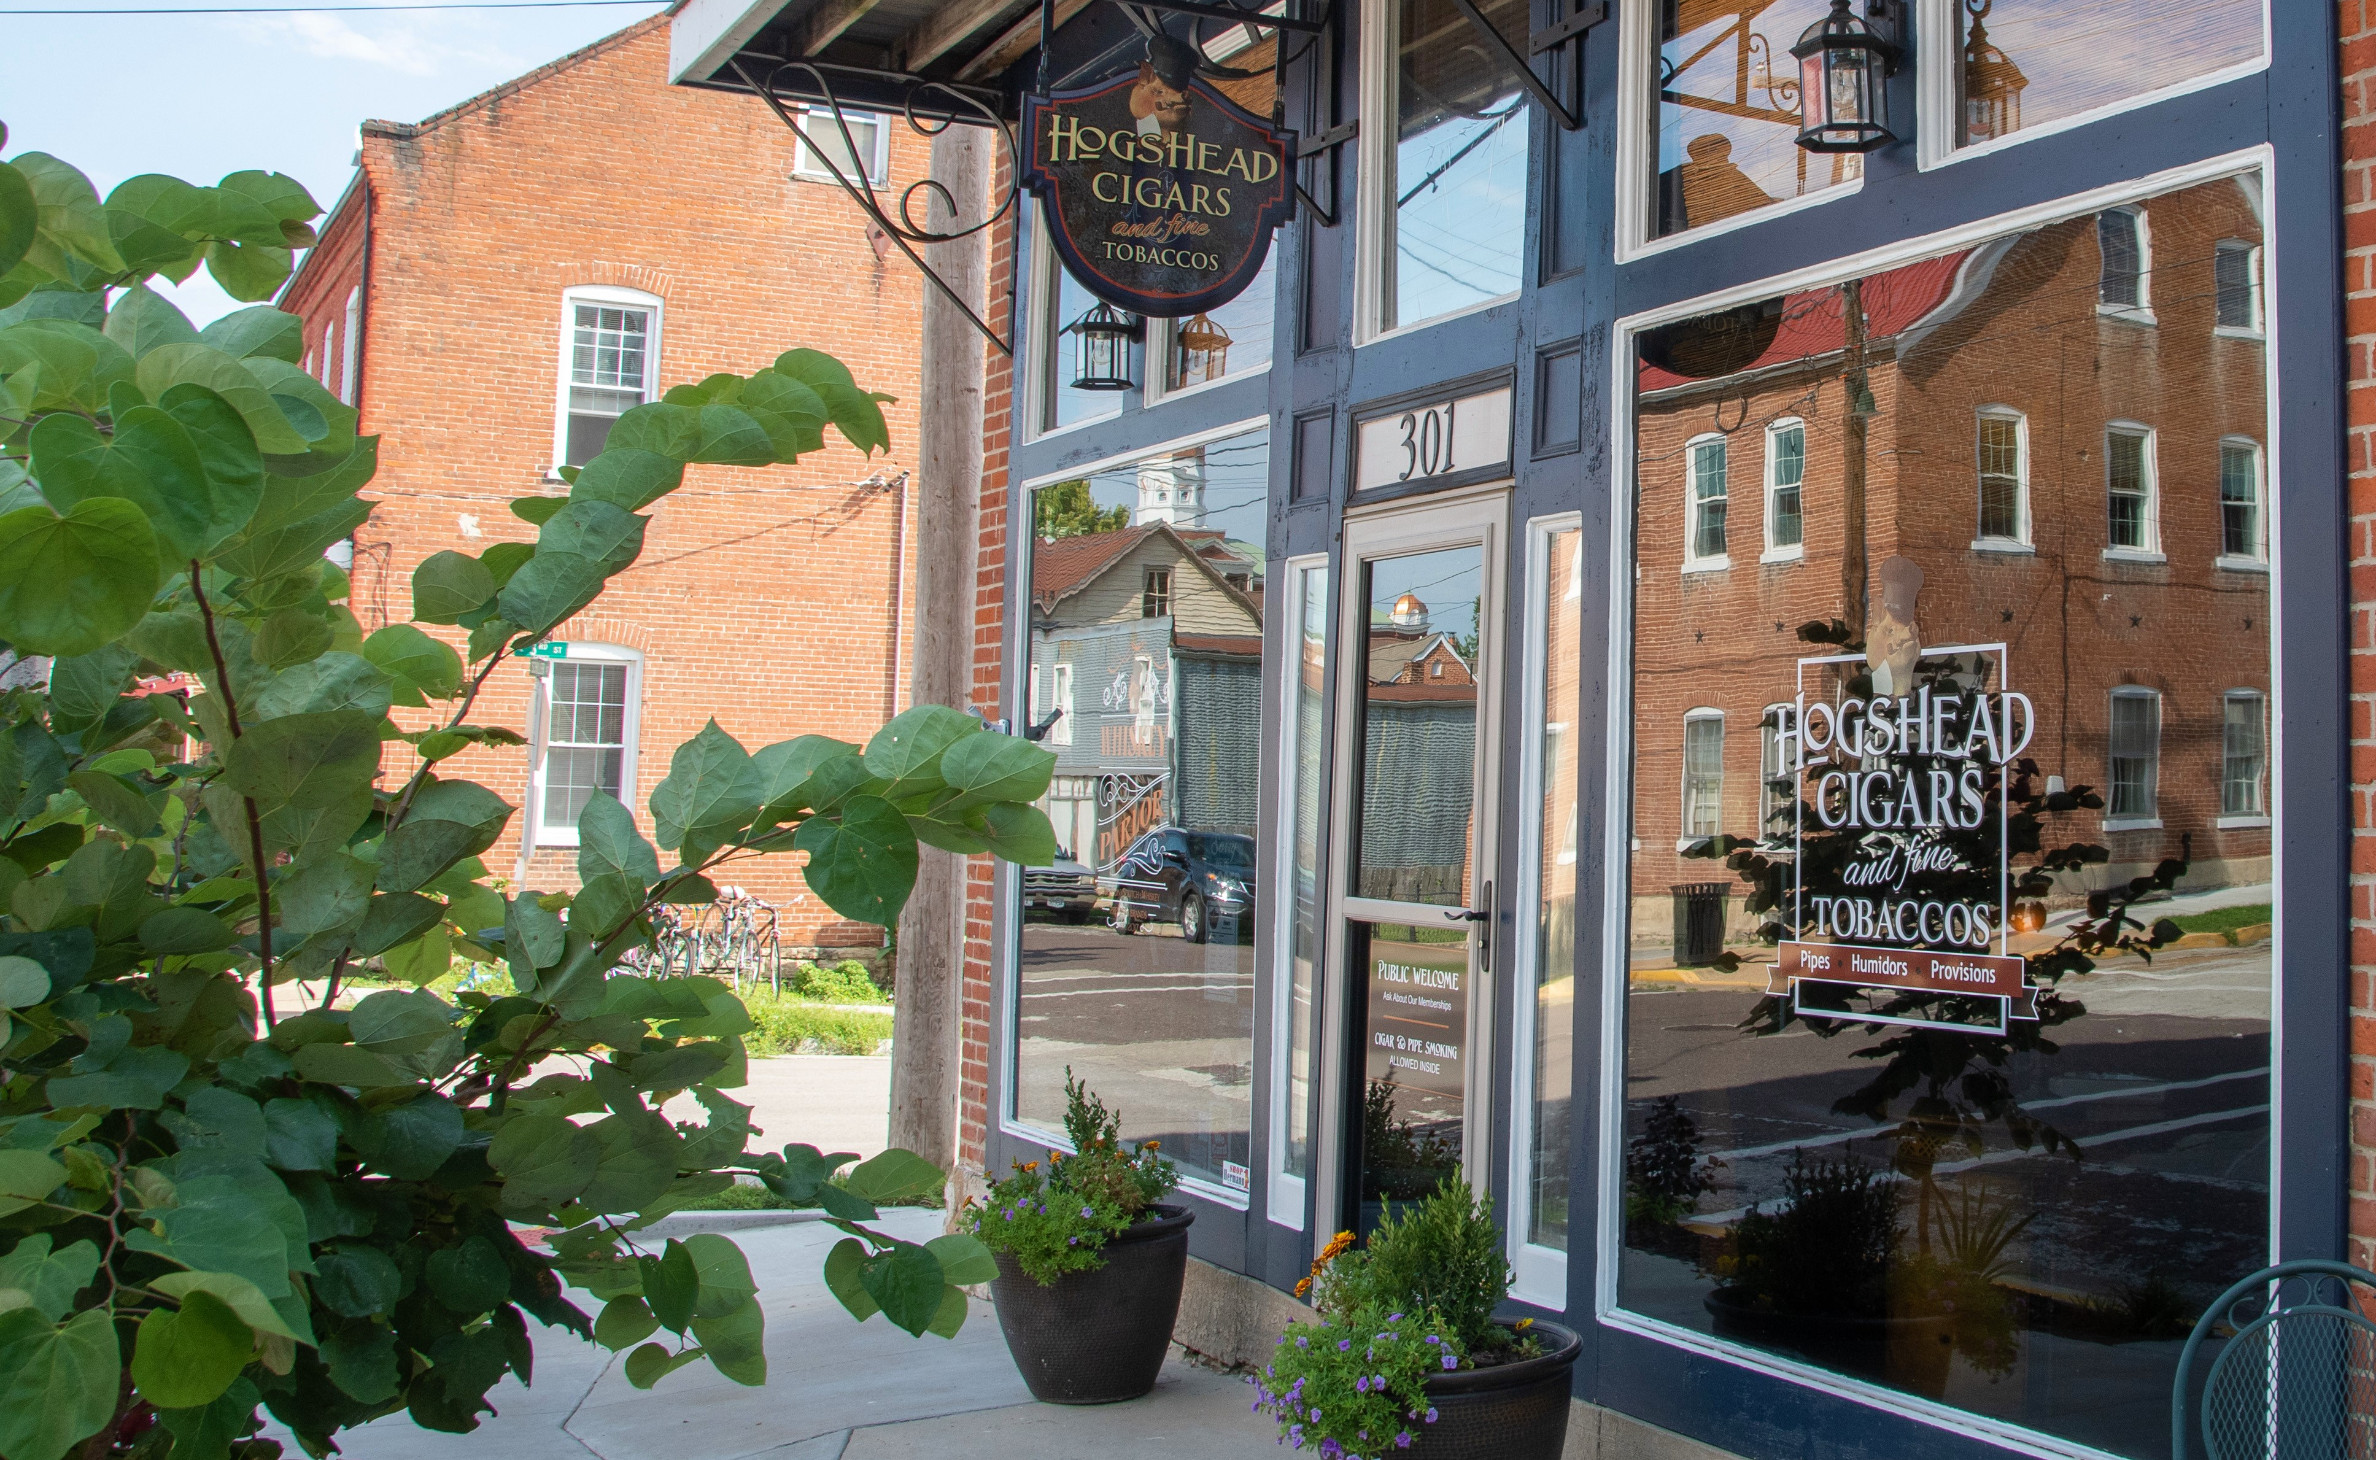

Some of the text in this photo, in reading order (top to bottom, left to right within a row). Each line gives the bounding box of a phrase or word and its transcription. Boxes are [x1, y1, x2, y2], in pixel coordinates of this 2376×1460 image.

[1048, 114, 1278, 183] HOGSHEAD
[1092, 172, 1231, 217] CIGARS
[1112, 213, 1211, 243] and fine
[1102, 241, 1219, 271] TOBACCOS
[1399, 402, 1456, 481] 301
[553, 646, 563, 654] ST
[1101, 725, 1168, 757] WHISKEY
[1774, 682, 2036, 778] HOGSHEAD
[1817, 769, 1984, 830] CIGARS
[1099, 789, 1165, 860] PARLOR
[1844, 834, 1953, 891] and fine
[1811, 896, 1992, 947] TOBACCOS
[1378, 960, 1459, 991] PUBLIC WELCOME
[1800, 950, 1996, 984] Pipes Humidors Provisions
[1383, 991, 1452, 1012] Ask About Our Memberships
[1374, 1031, 1395, 1049] CIGAR
[1408, 1038, 1423, 1053] PIPE
[1425, 1041, 1457, 1060] SMOKING
[1389, 1055, 1440, 1075] ALLOWED INSIDE
